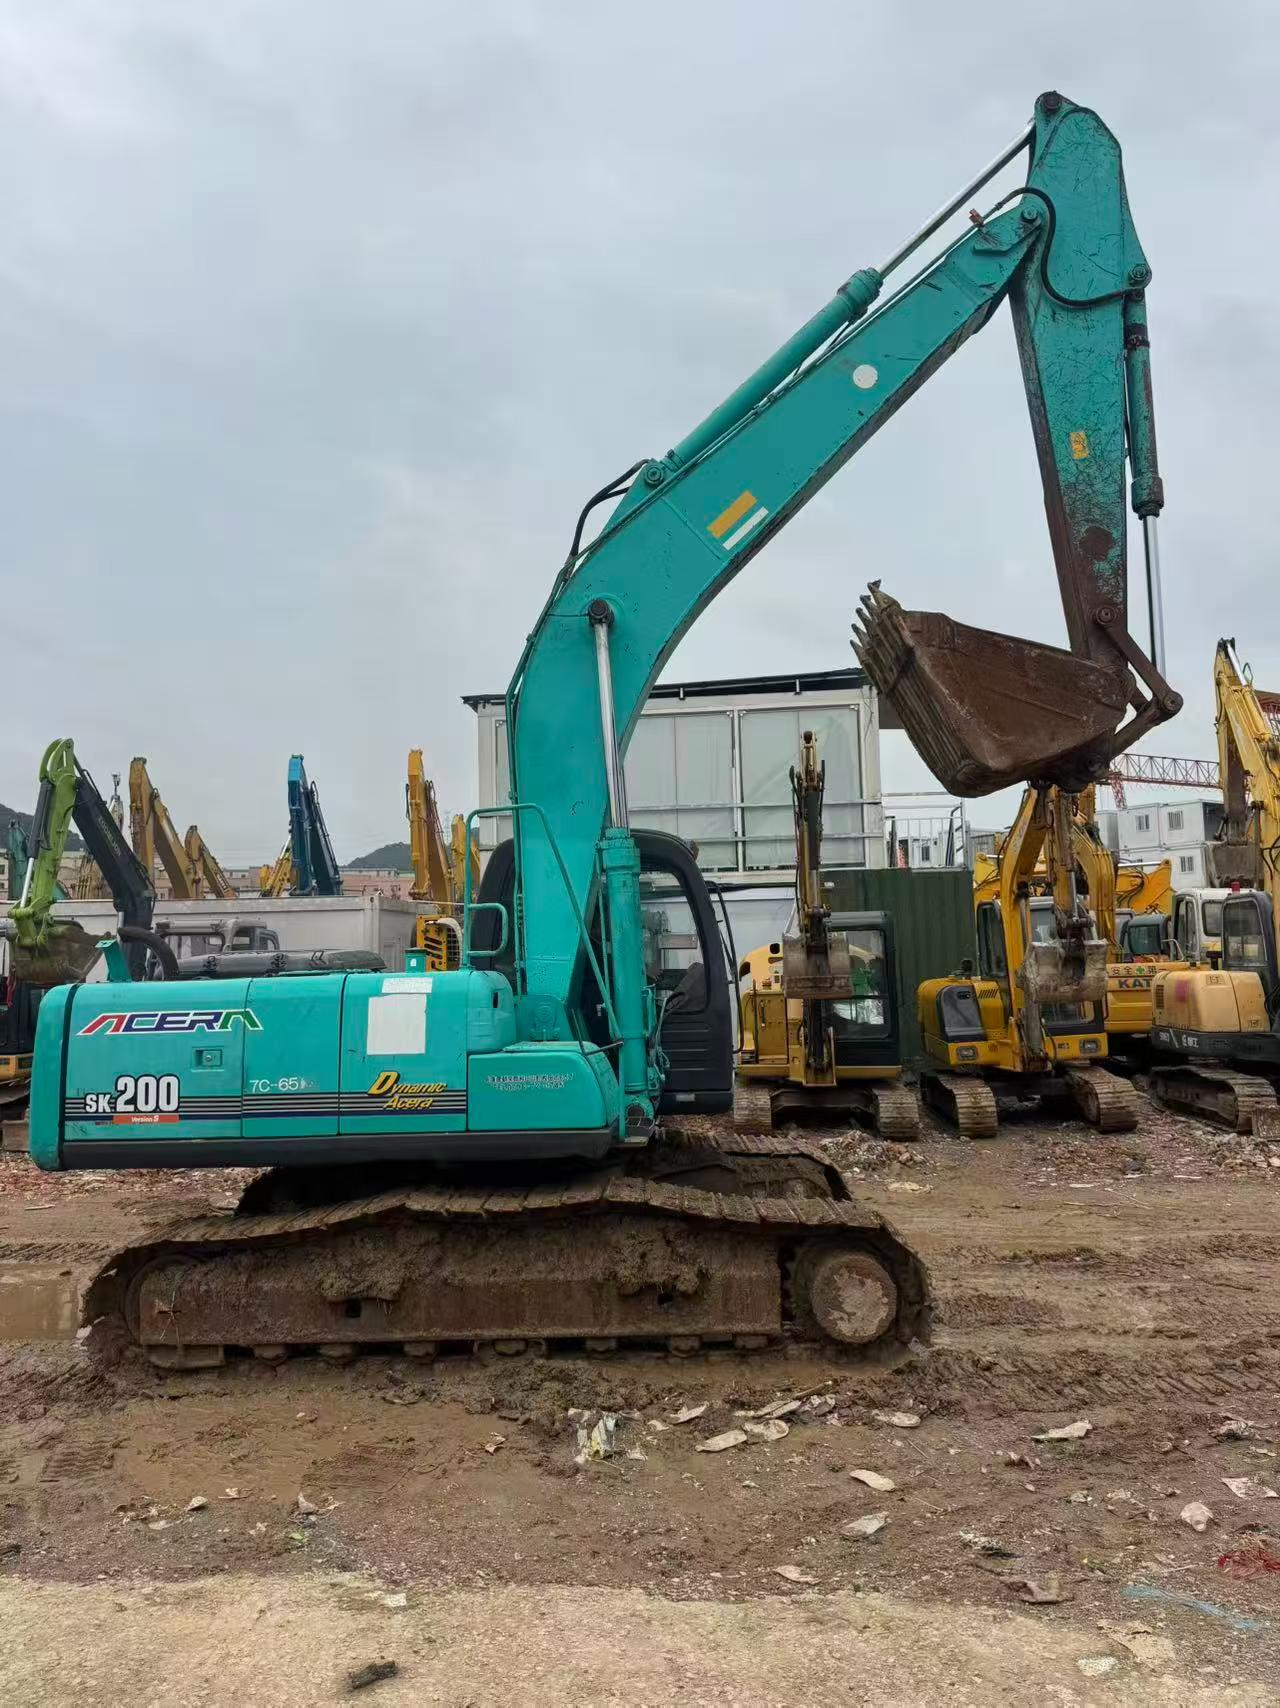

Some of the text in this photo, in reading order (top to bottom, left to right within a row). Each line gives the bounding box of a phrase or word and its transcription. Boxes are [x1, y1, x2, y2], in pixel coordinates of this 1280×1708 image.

[1118, 978, 1151, 989] KAT
[76, 1009, 263, 1035] ACERA
[367, 1071, 448, 1095] Dynamic
[383, 1094, 434, 1110] Acera
